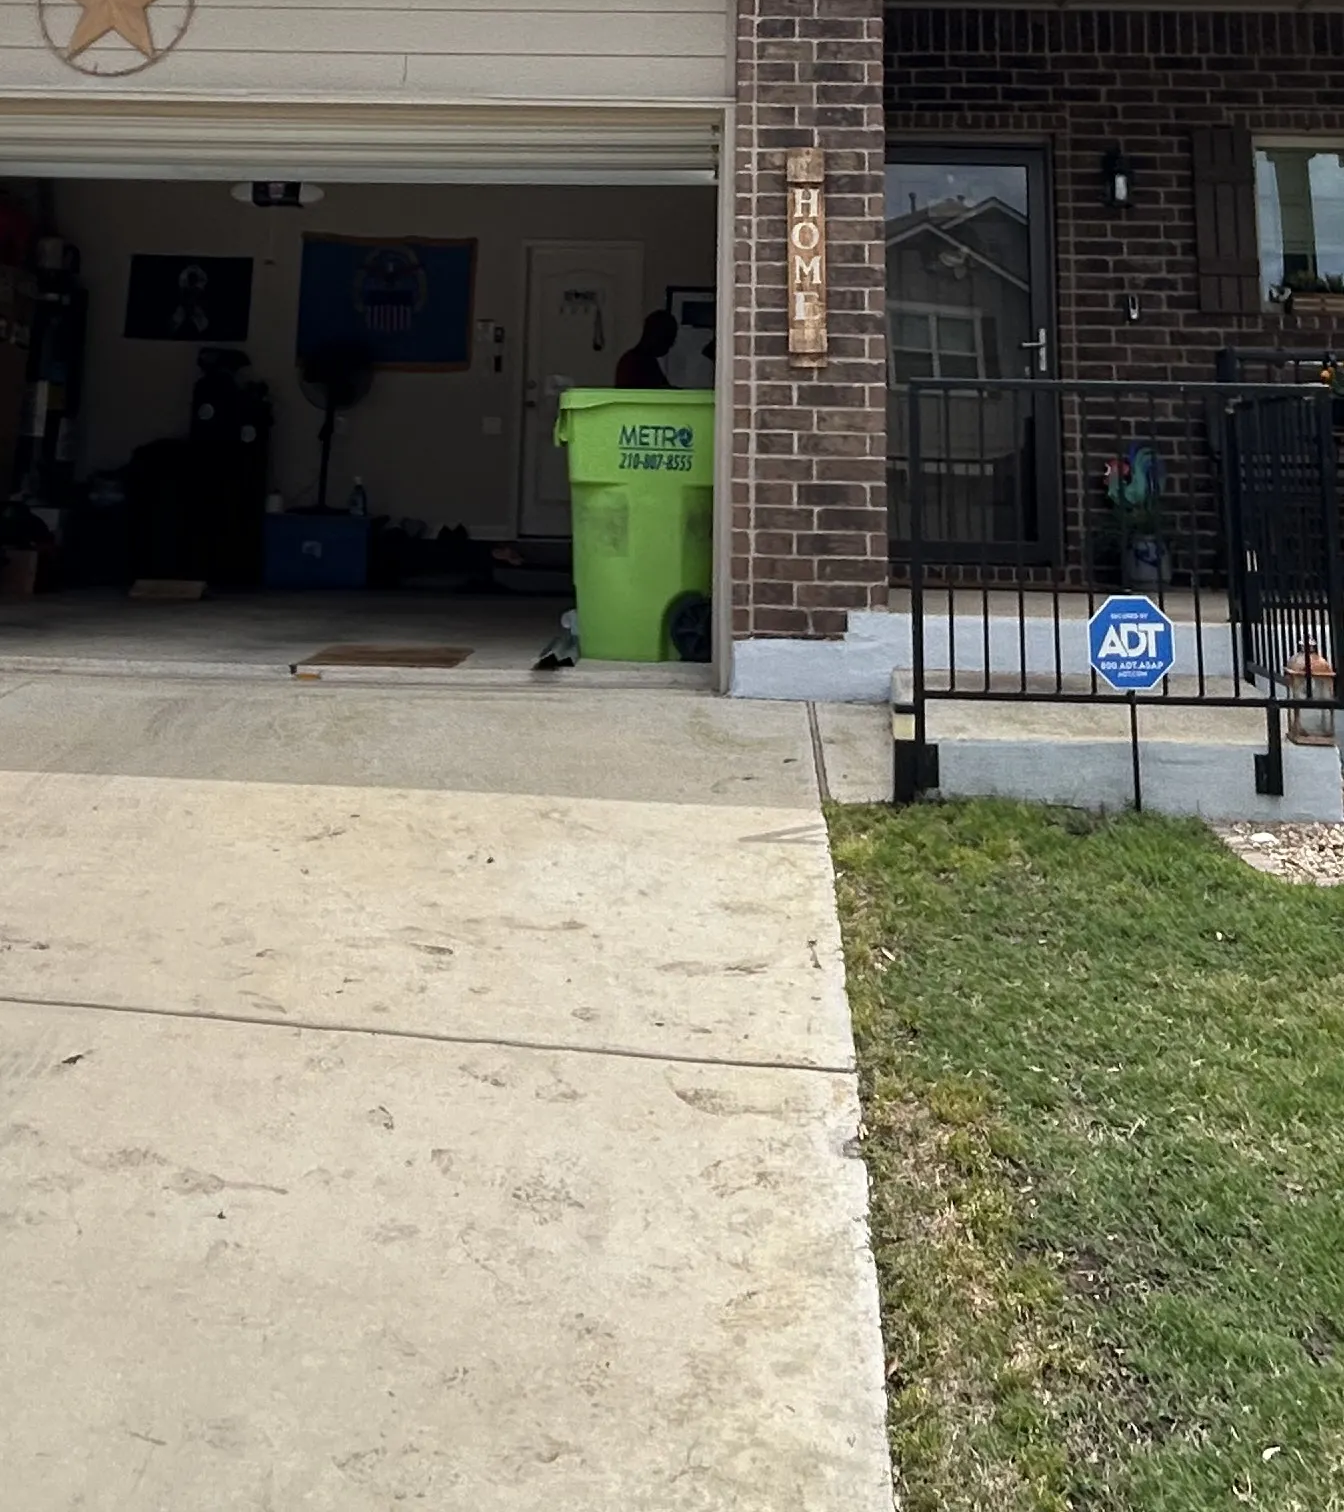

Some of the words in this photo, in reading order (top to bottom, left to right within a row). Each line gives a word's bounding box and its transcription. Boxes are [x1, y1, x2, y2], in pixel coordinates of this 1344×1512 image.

[791, 188, 823, 320] HOME
[619, 424, 693, 447] METRO
[1097, 623, 1164, 657] ADT
